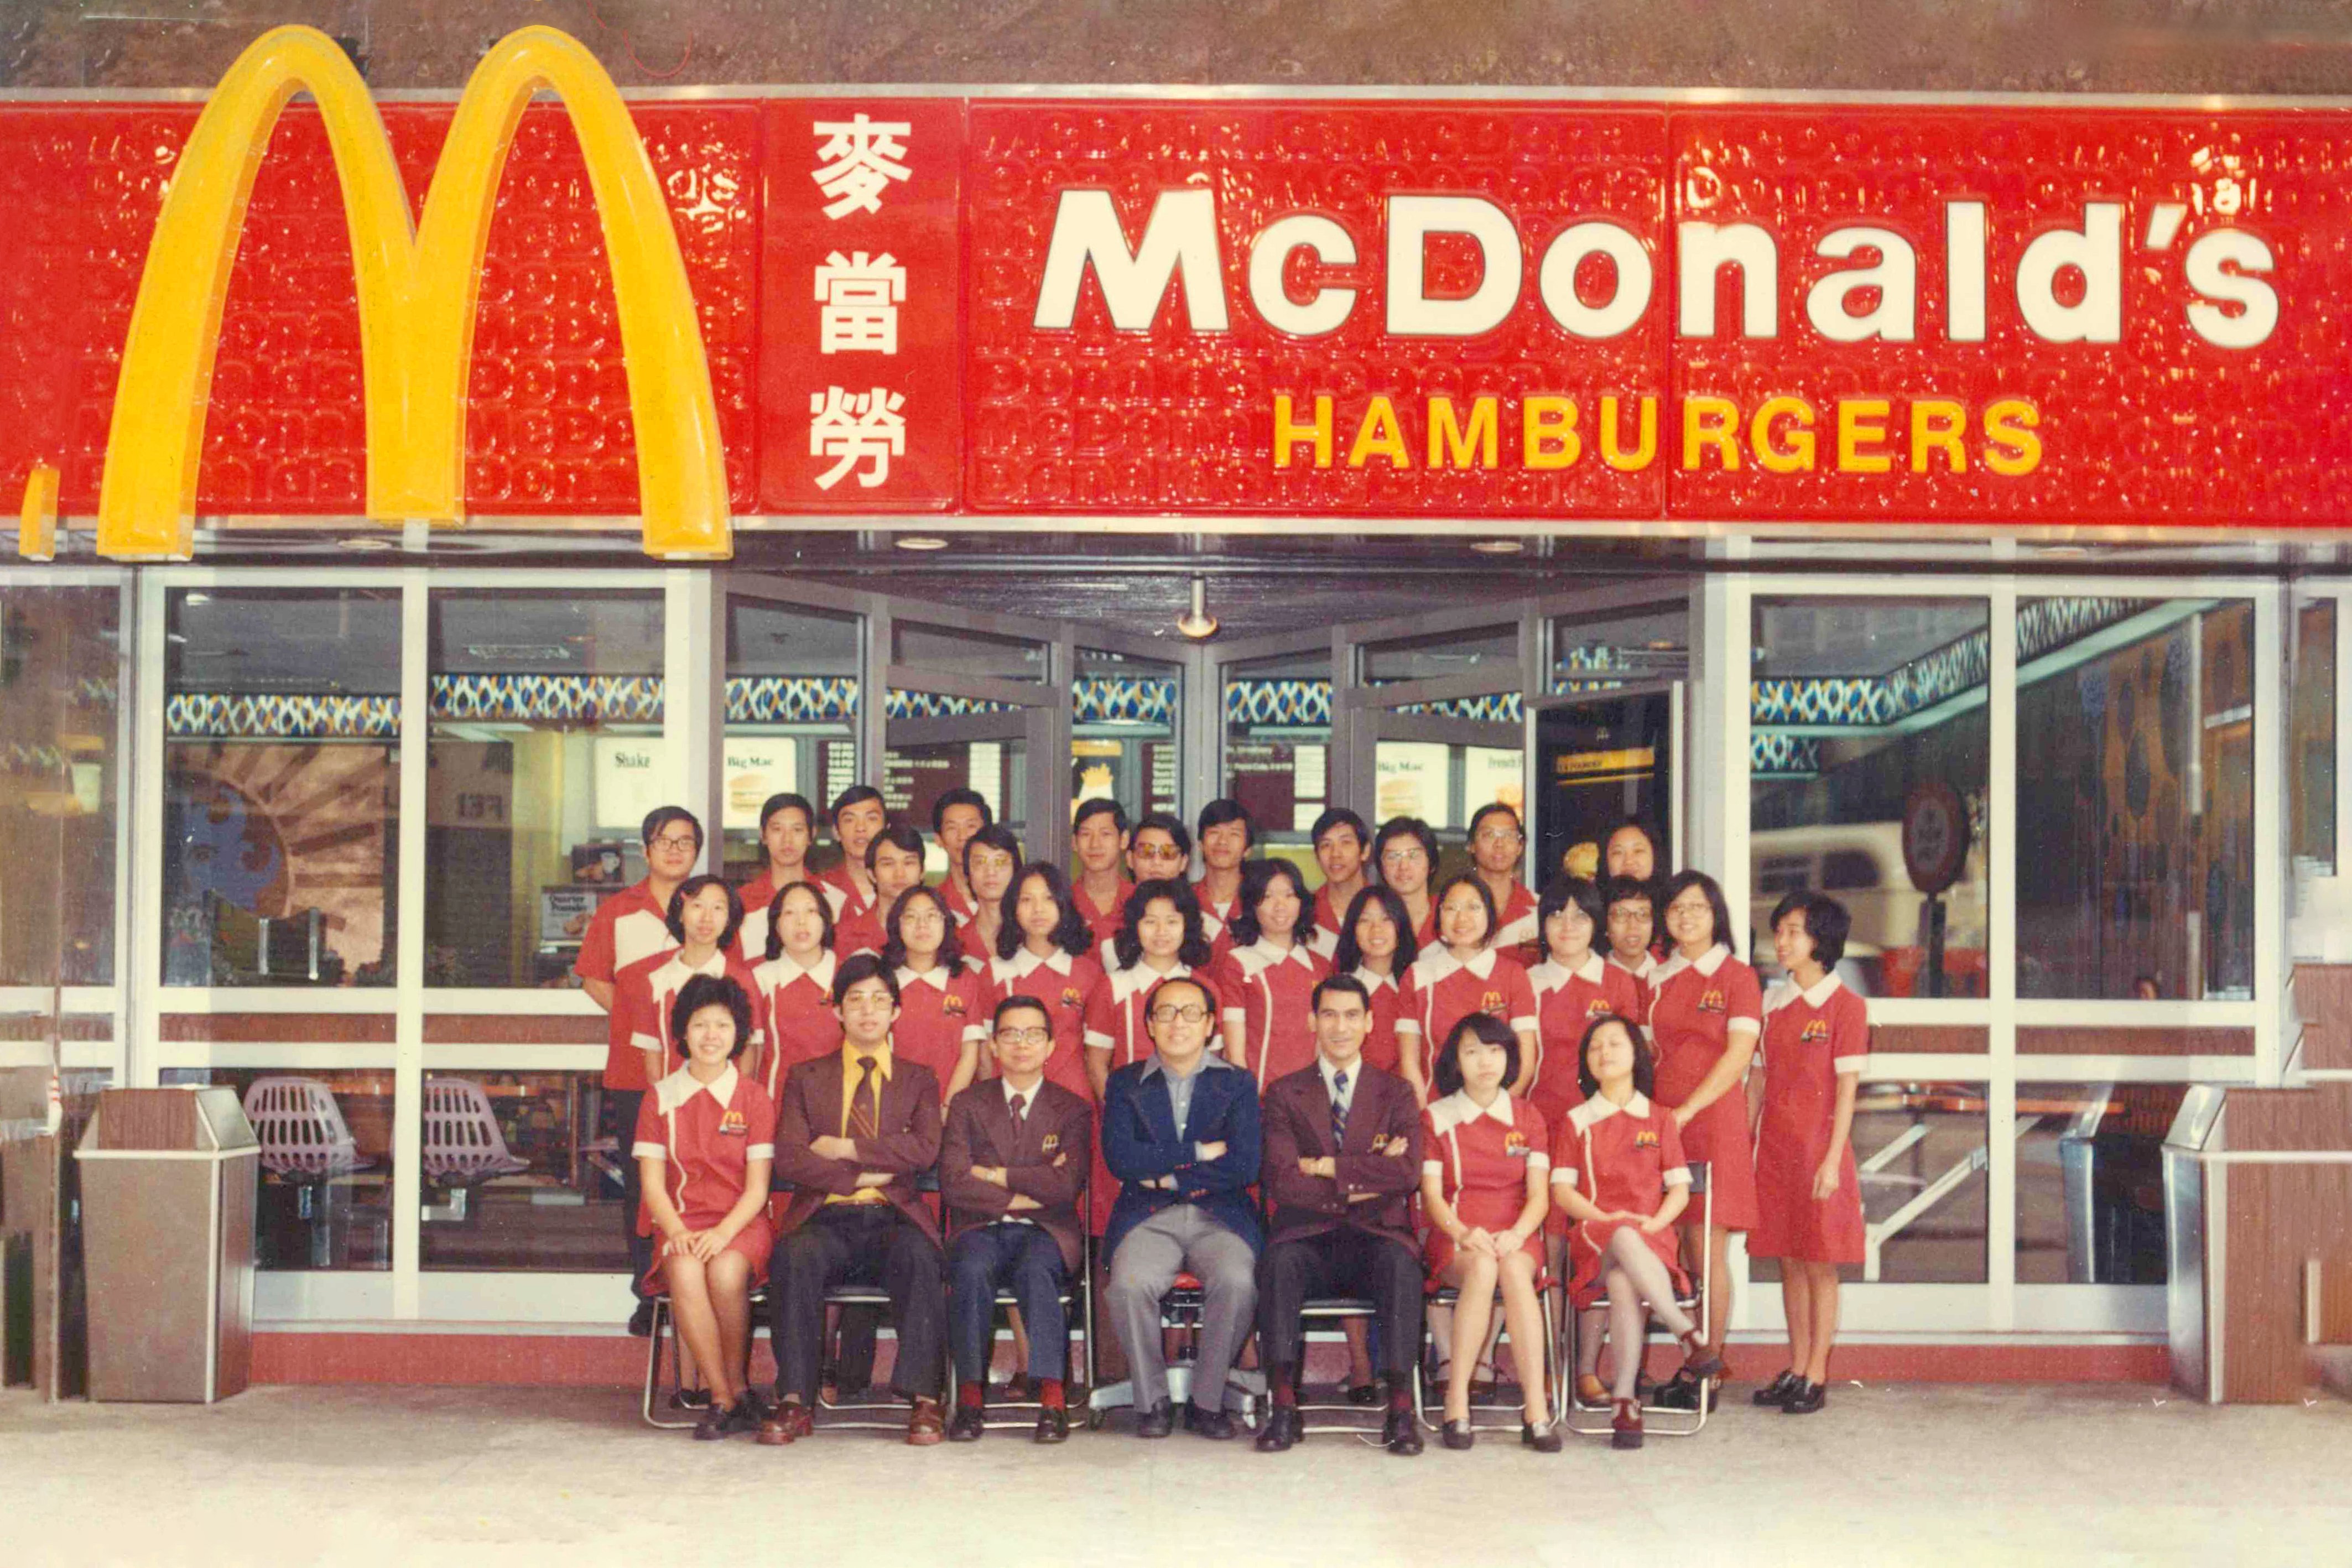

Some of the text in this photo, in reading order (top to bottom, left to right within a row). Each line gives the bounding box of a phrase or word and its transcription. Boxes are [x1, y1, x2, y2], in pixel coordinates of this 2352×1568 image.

[811, 113, 912, 490] 麥當勞
[1033, 189, 2278, 348] McDonald's
[1274, 395, 2041, 475] HAMBURGERS
[615, 751, 651, 768] Shake
[728, 756, 773, 769] Big Mac
